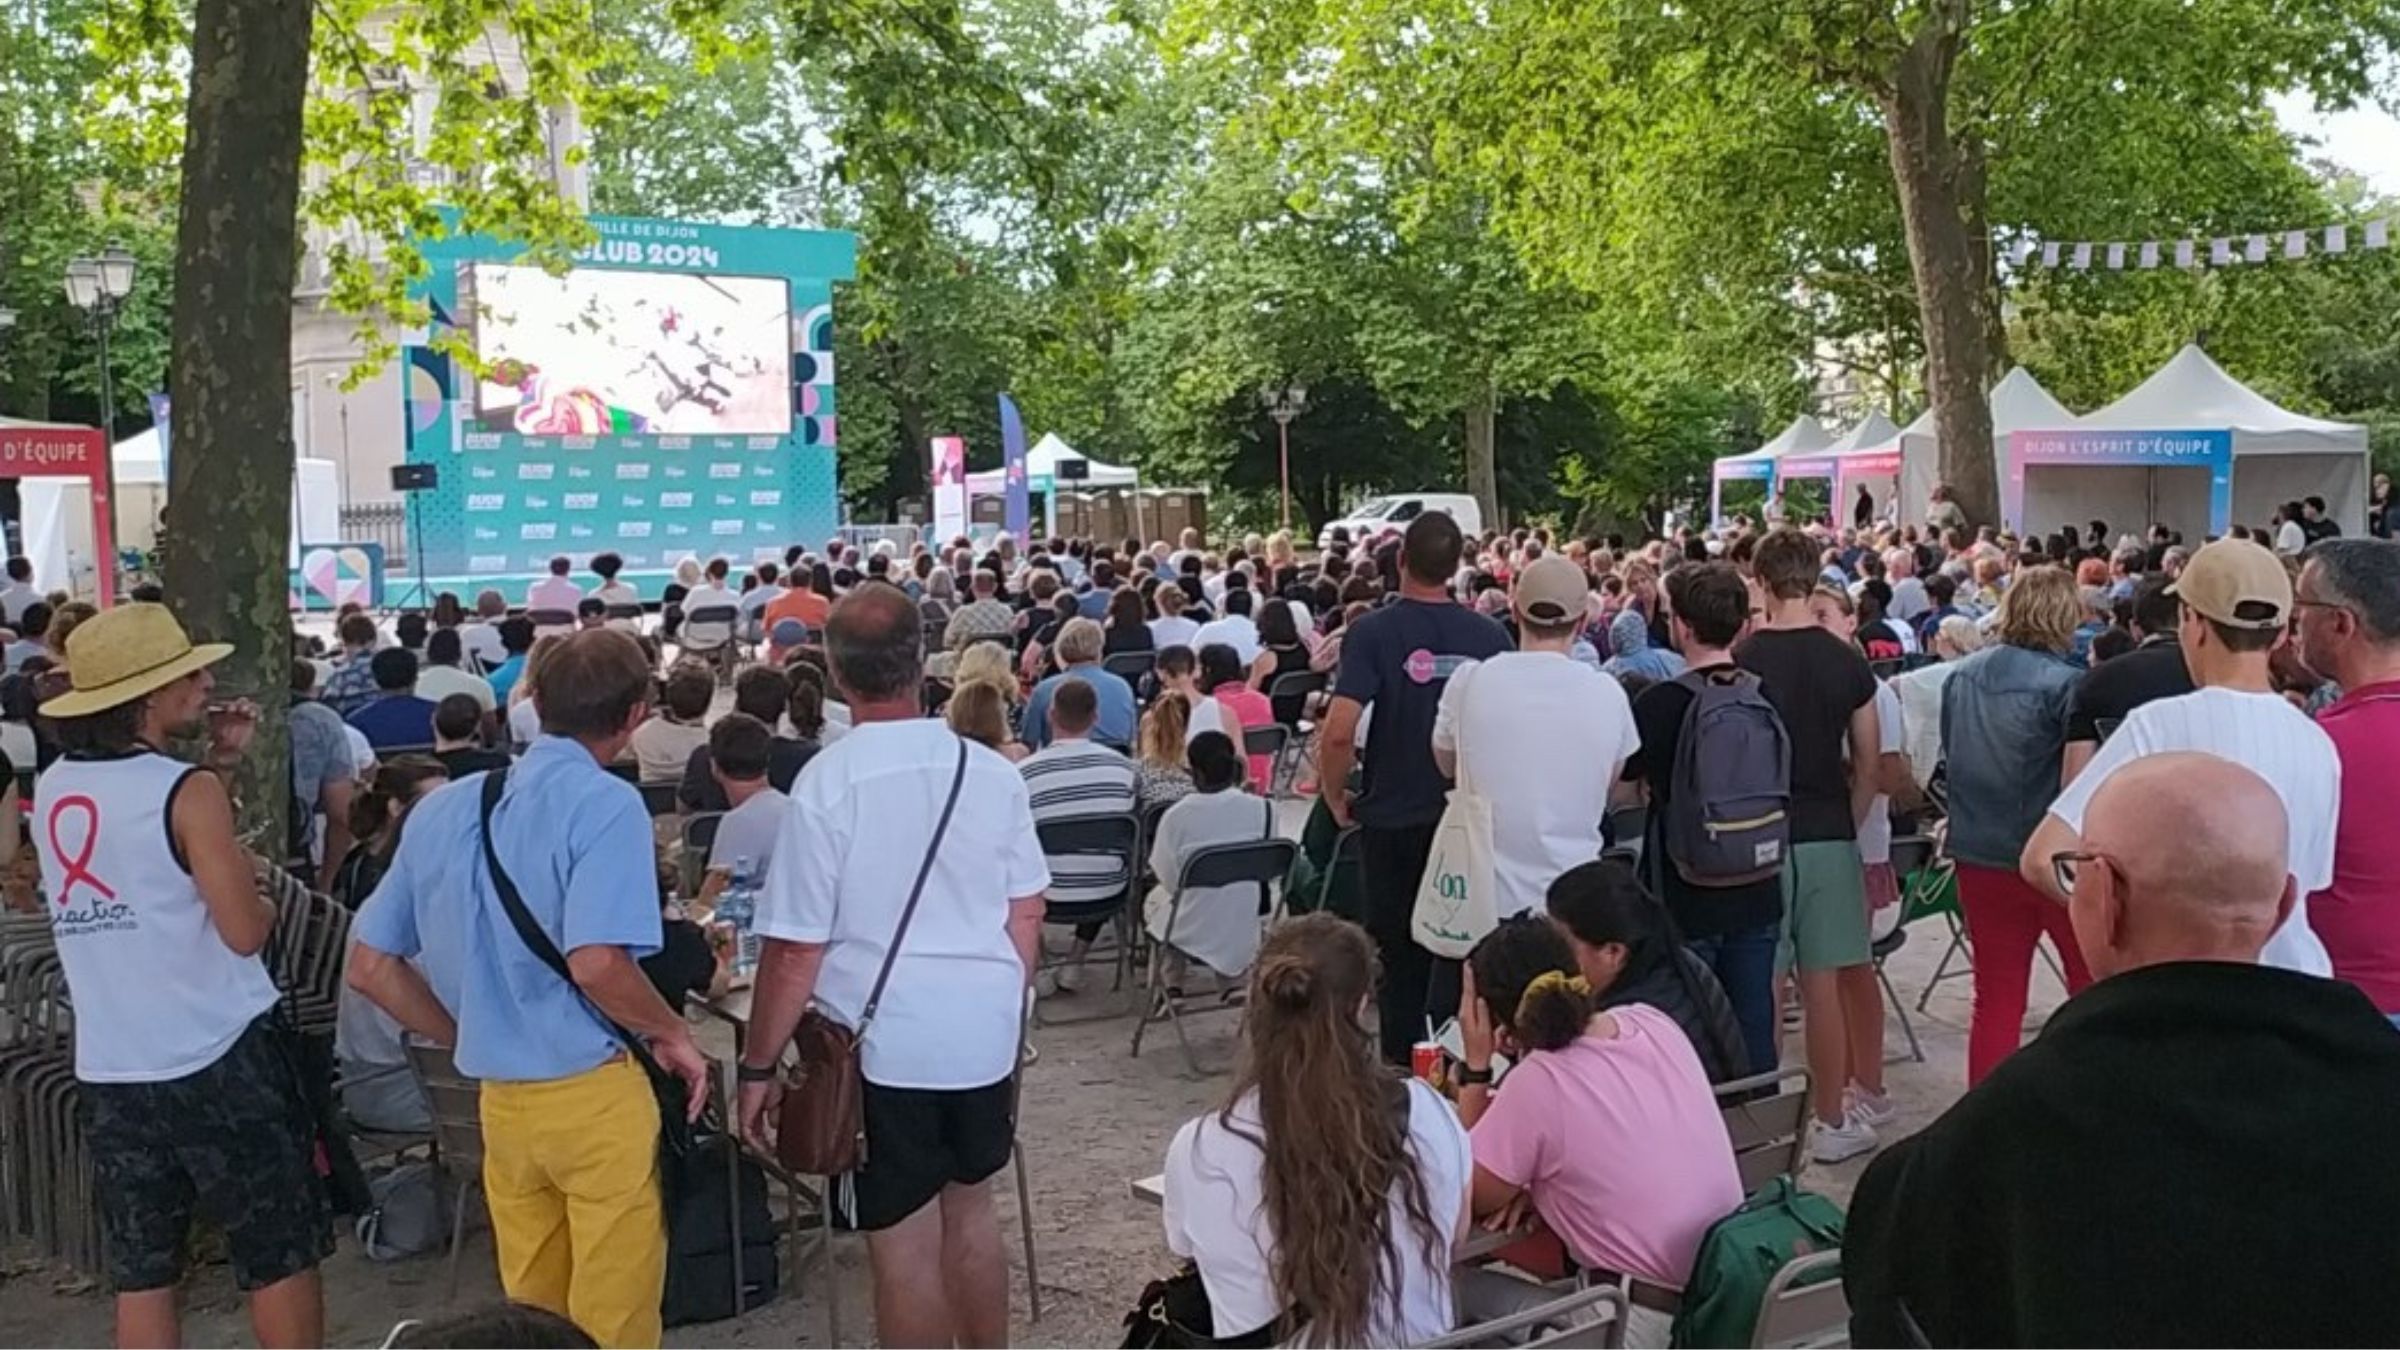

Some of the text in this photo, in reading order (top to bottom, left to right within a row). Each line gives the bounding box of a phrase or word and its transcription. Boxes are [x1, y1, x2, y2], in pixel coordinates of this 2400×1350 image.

[633, 224, 650, 237] DE
[656, 226, 699, 239] DIJON
[647, 243, 719, 268] 2024
[4, 437, 87, 465] D'ÉQUIPE
[2024, 437, 2212, 456] DIJON L'ESPRIT D'ÉQUIPE
